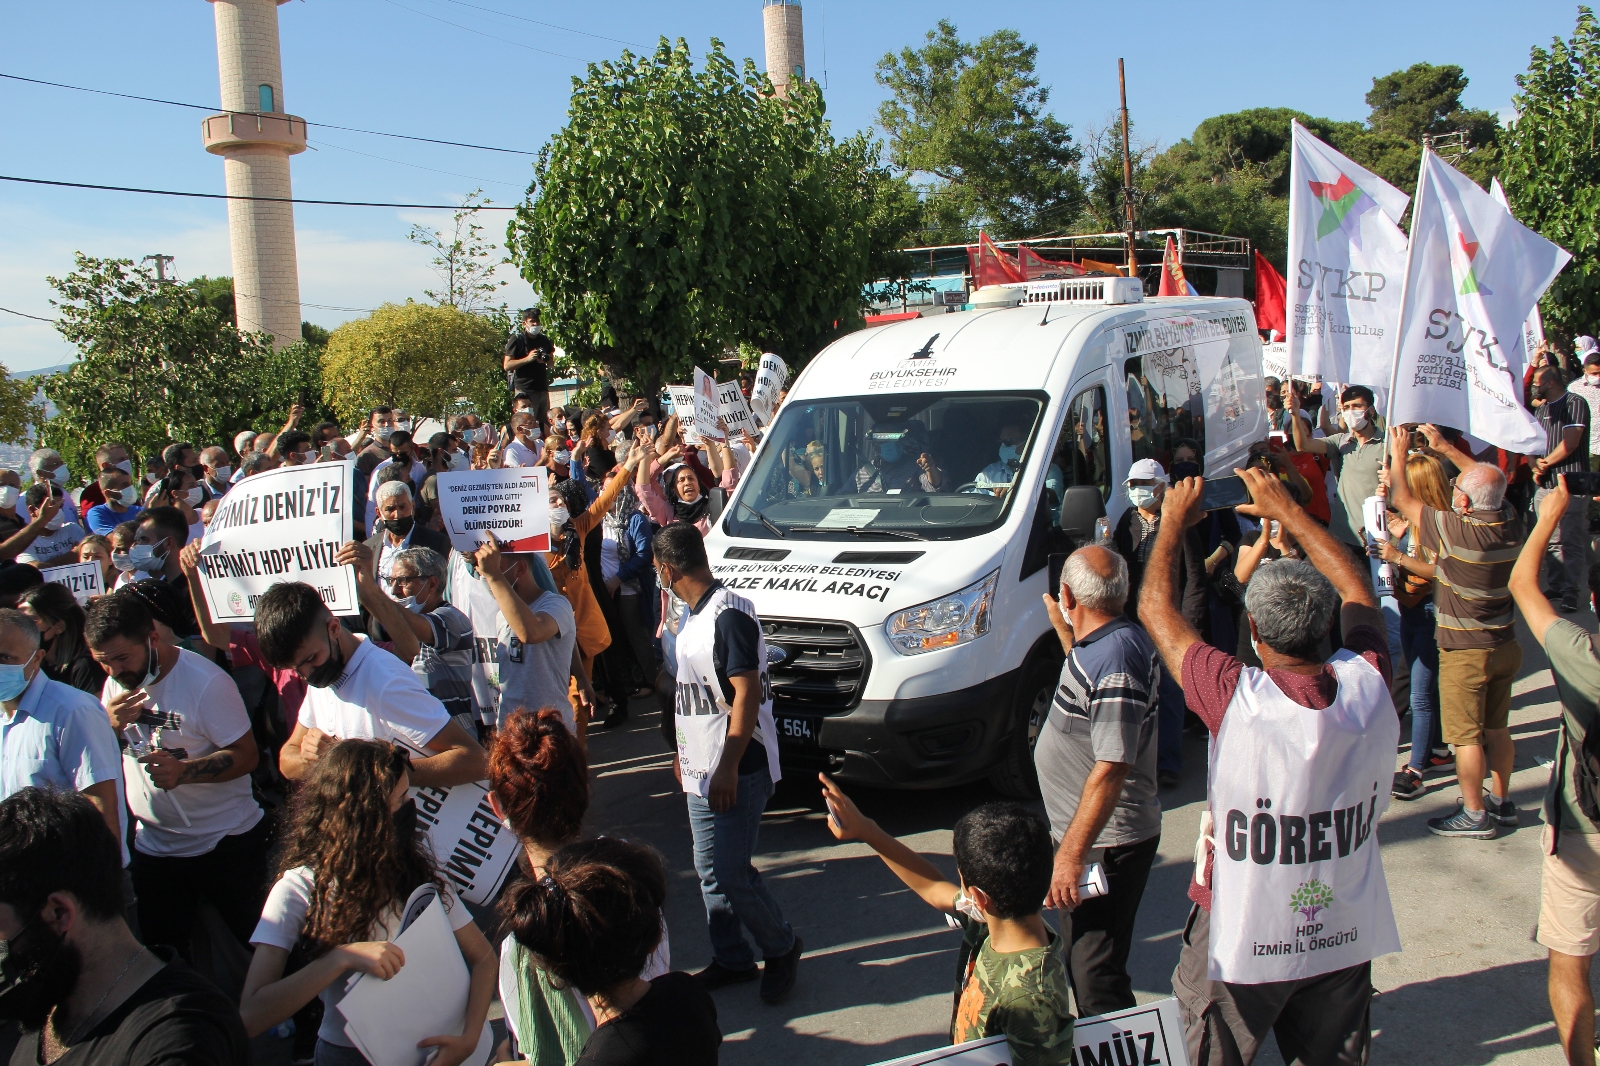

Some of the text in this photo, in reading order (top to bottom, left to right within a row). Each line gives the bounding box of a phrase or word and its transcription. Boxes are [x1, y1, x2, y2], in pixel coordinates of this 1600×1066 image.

[1412, 372, 1462, 390] partisi
[263, 482, 340, 522] DENİZ'İZ
[462, 504, 521, 515] DENİZ POYRAZ
[464, 518, 523, 530] ÖLÜMSÜZDÜR!
[206, 549, 261, 579] HEPİMİZ
[737, 562, 822, 575] BÜYÜKŞEHİR
[819, 566, 902, 582] BELEDİYESİ
[718, 577, 890, 602] NAZE NAKİL ARACI
[1225, 781, 1378, 865] GÖREVLİ
[1253, 926, 1358, 956] İZMİR İL ÖRGÜTÜ
[1296, 923, 1324, 938] HDP
